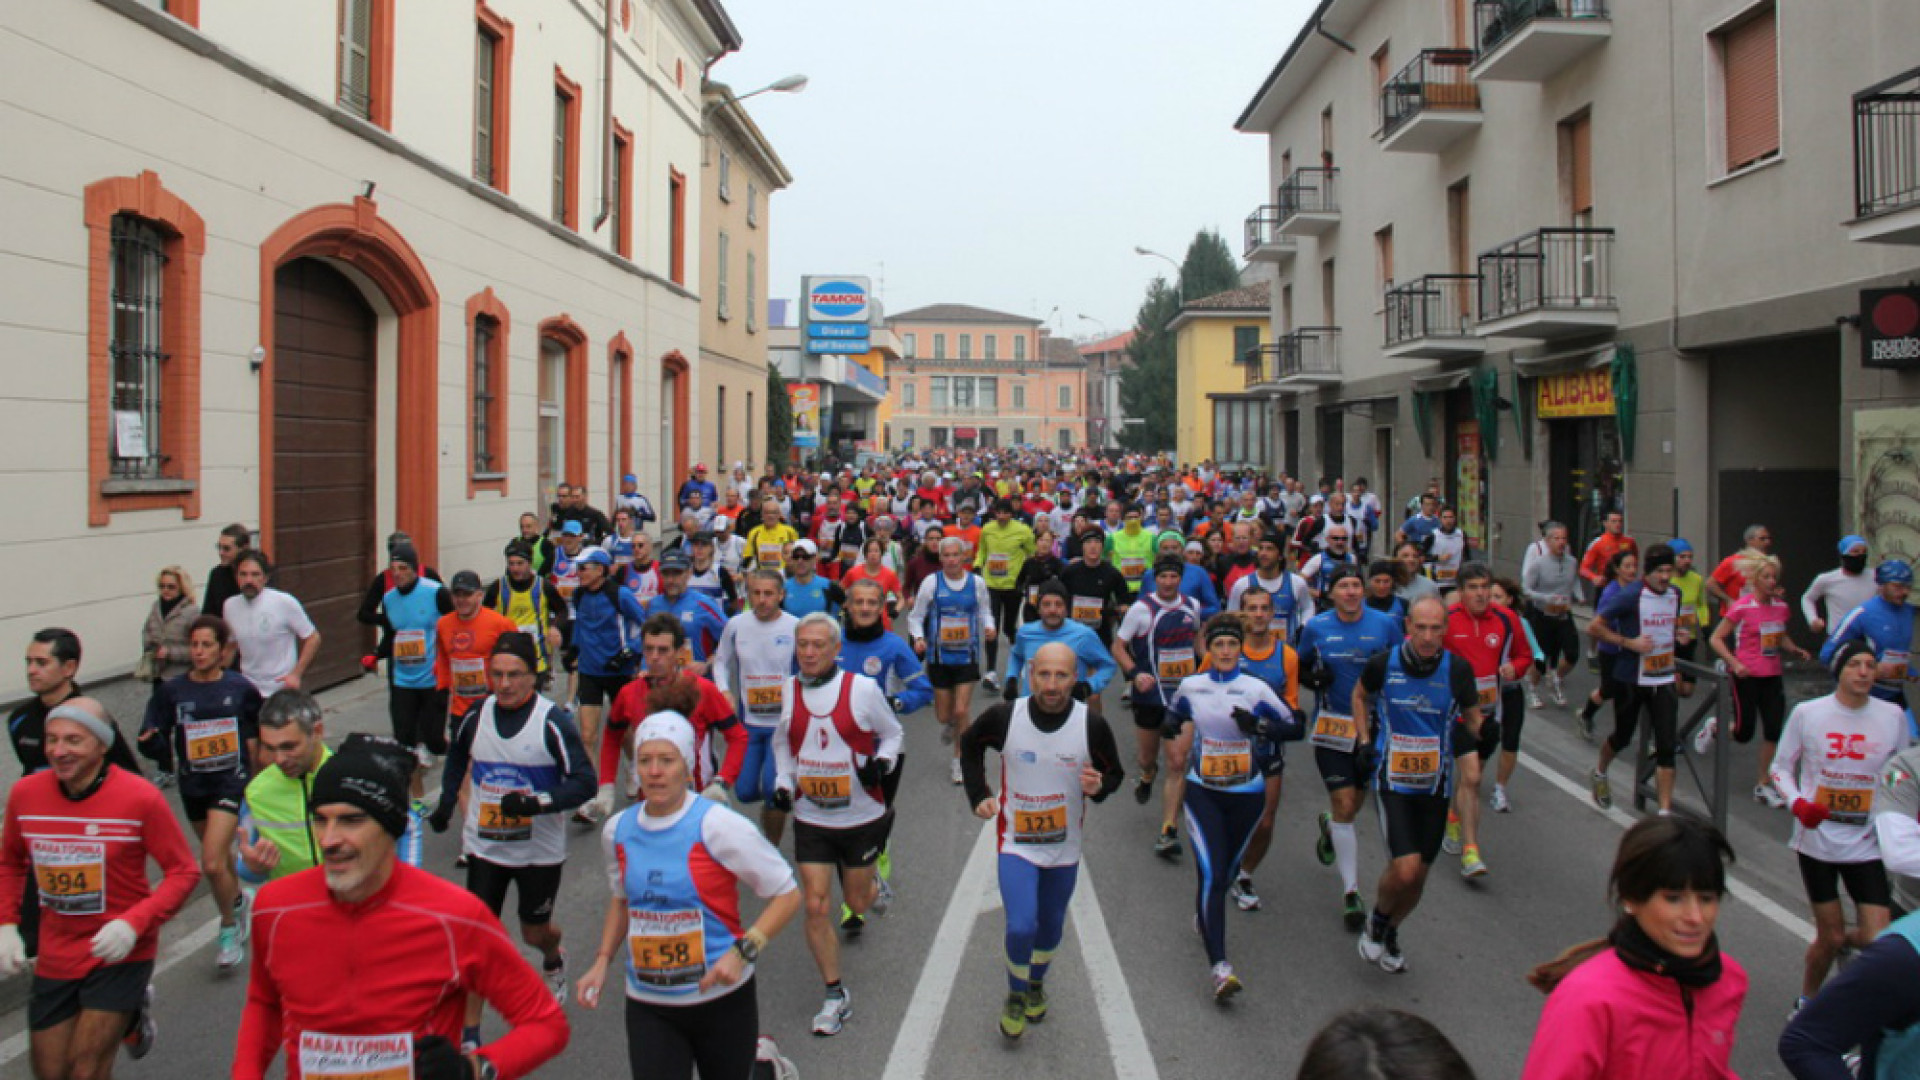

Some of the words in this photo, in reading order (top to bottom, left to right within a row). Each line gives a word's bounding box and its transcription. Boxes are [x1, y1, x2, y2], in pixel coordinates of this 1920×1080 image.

[811, 294, 867, 304] TAMOIL
[821, 325, 856, 336] Diesel
[208, 738, 229, 755] 83
[1399, 757, 1431, 772] 438
[809, 781, 840, 798] 101
[1827, 793, 1862, 810] 190
[1024, 814, 1057, 832] 121
[46, 871, 88, 892] 394
[642, 949, 652, 966] F
[659, 942, 690, 965] 58
[302, 1035, 410, 1055] MARATONINA
